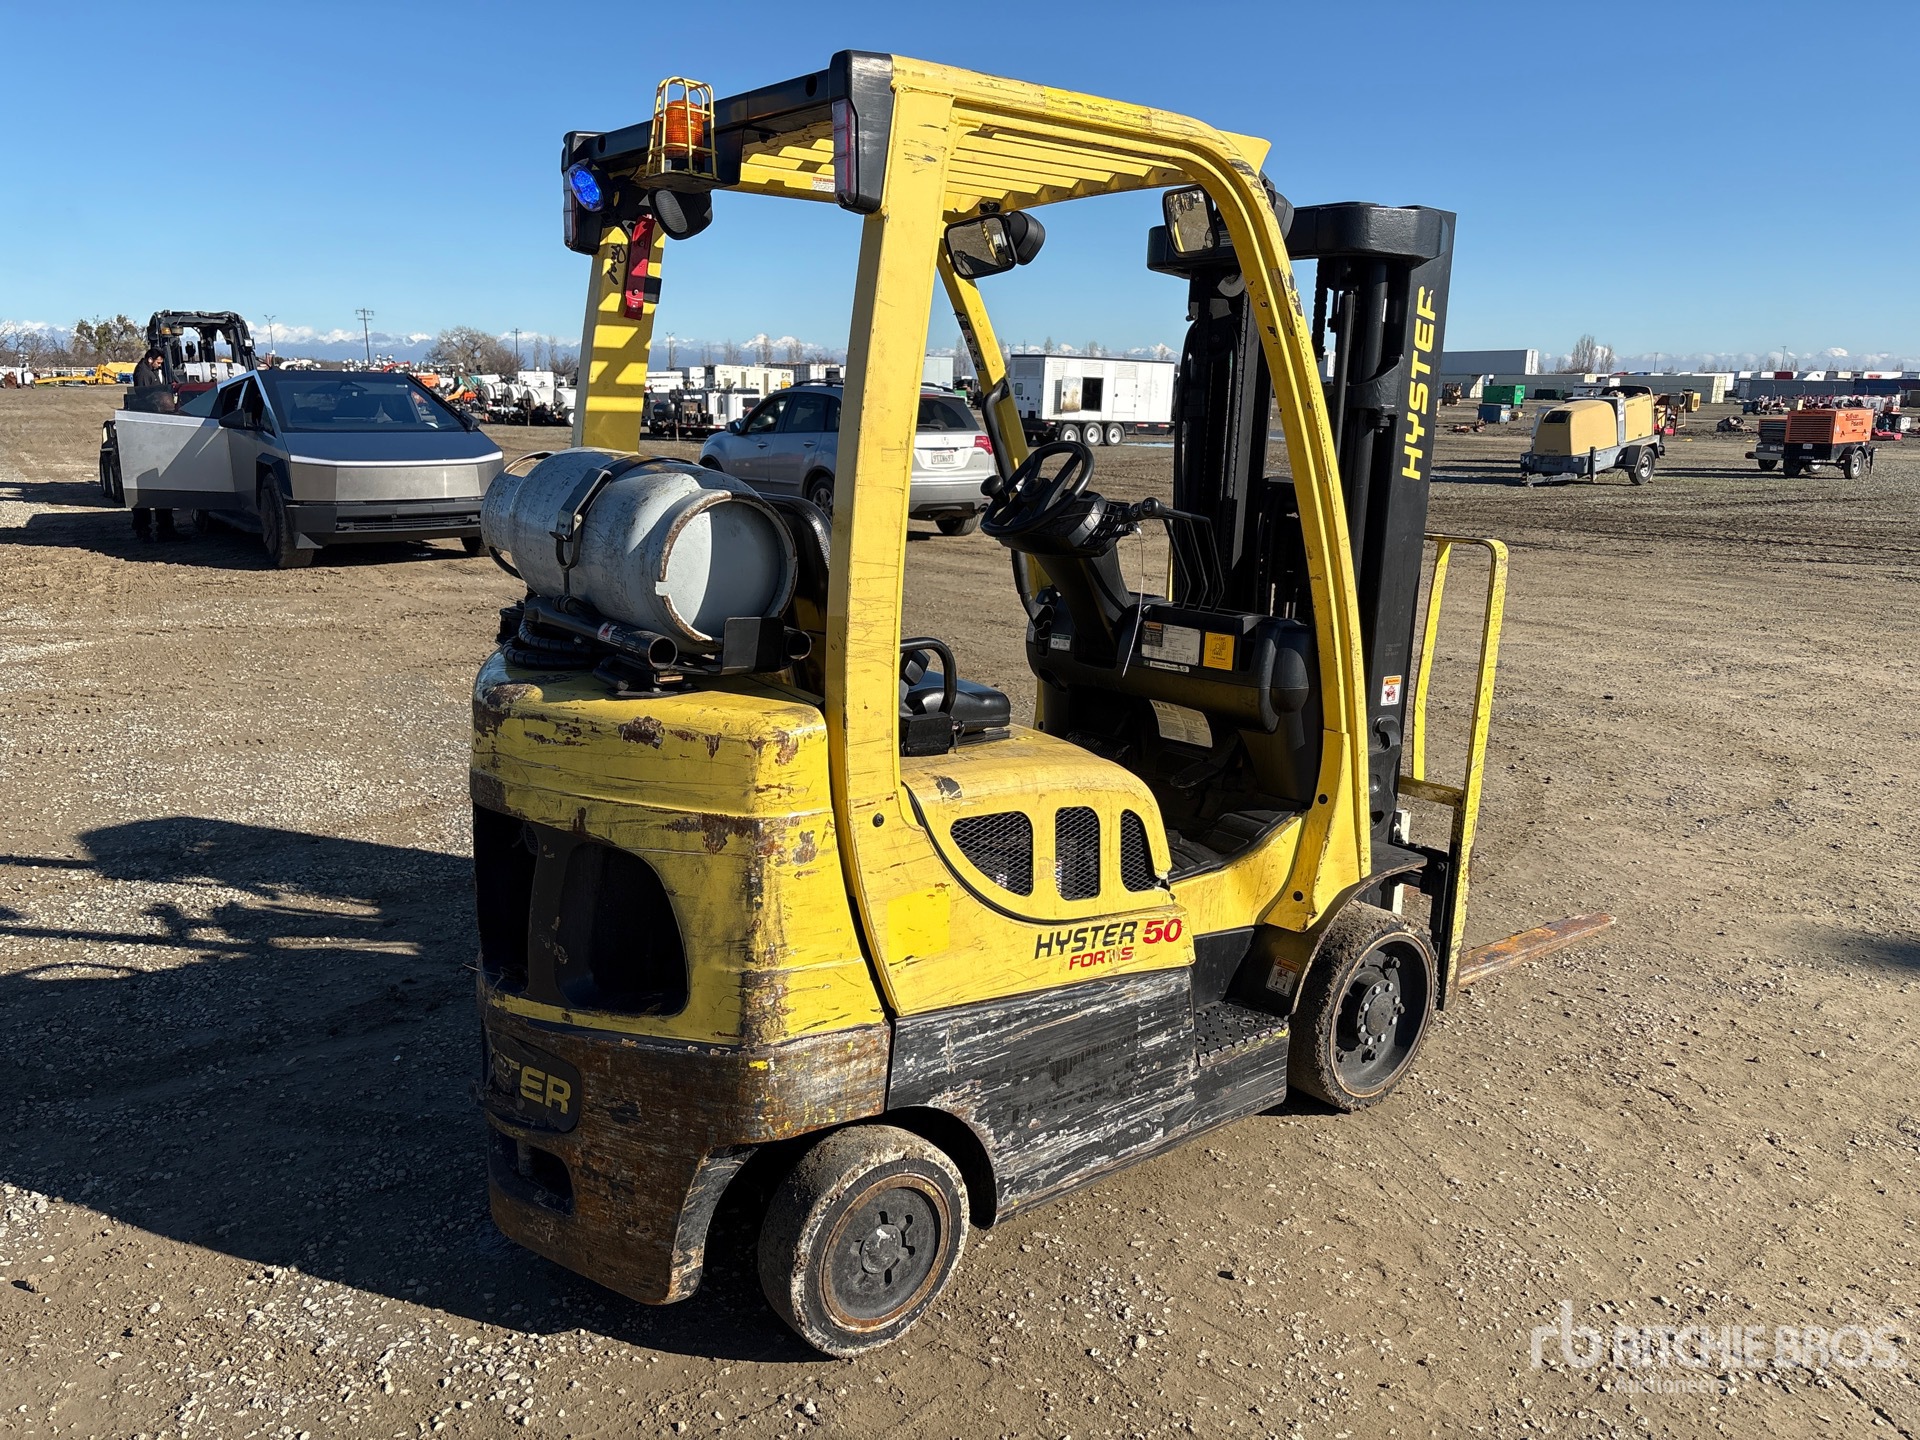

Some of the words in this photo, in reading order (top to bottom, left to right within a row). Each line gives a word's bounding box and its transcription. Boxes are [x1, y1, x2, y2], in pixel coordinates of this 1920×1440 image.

[1520, 455, 1530, 465] 34
[1034, 921, 1138, 960] HYSTER
[1142, 918, 1183, 945] 50
